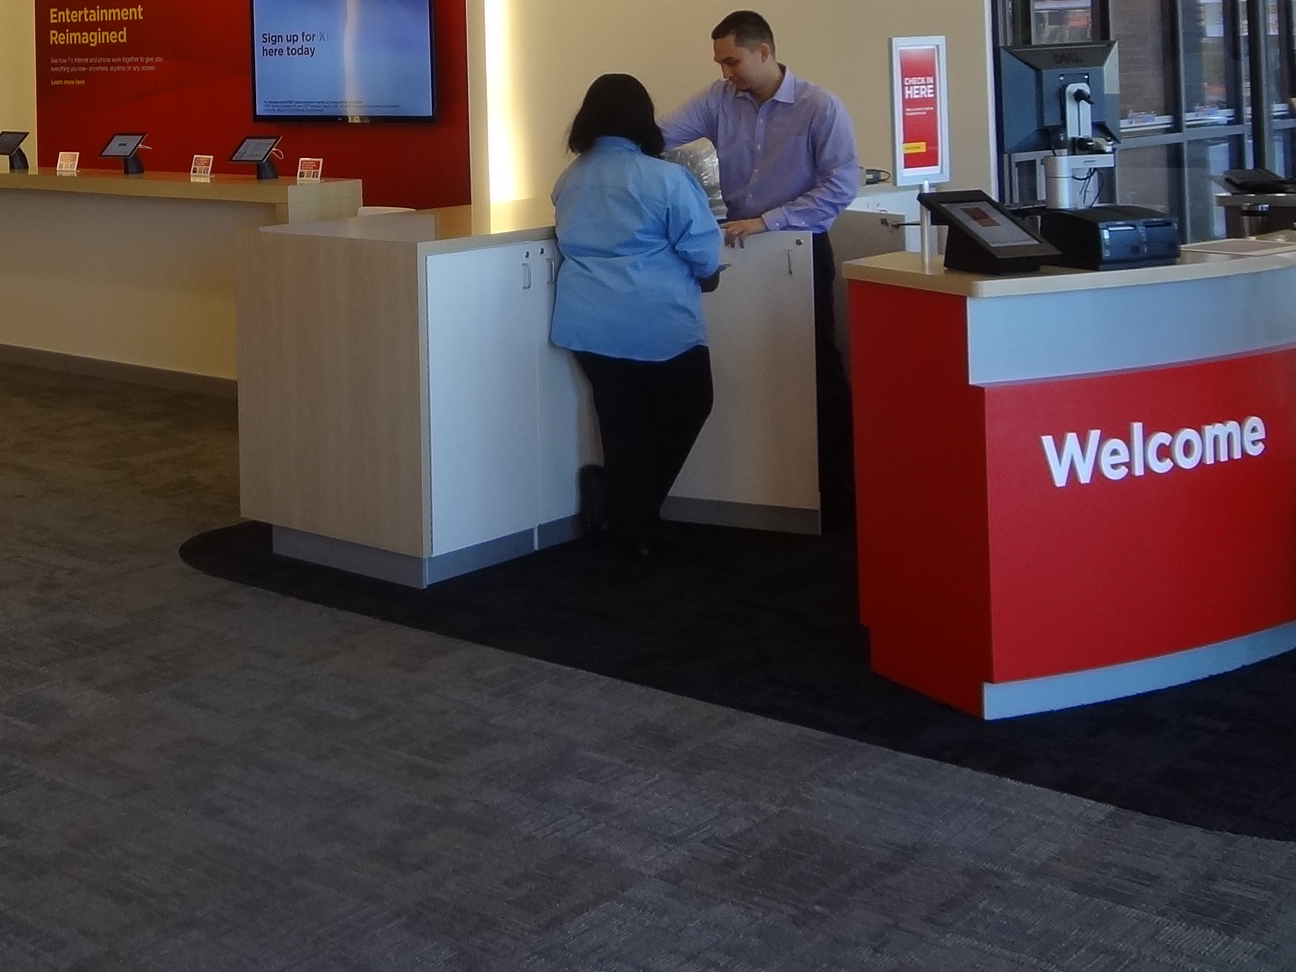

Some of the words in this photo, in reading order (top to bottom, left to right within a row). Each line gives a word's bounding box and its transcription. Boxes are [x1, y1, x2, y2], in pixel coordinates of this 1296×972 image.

[49, 4, 144, 23] Entertainment
[49, 26, 127, 47] Reimagined
[261, 32, 283, 45] Sign
[286, 33, 299, 44] up
[301, 31, 315, 42] for
[262, 46, 284, 57] here
[286, 44, 316, 58] today
[903, 77, 926, 86] CHECK
[926, 76, 934, 84] IN
[904, 85, 935, 99] HERE
[1040, 415, 1266, 488] Welcome
